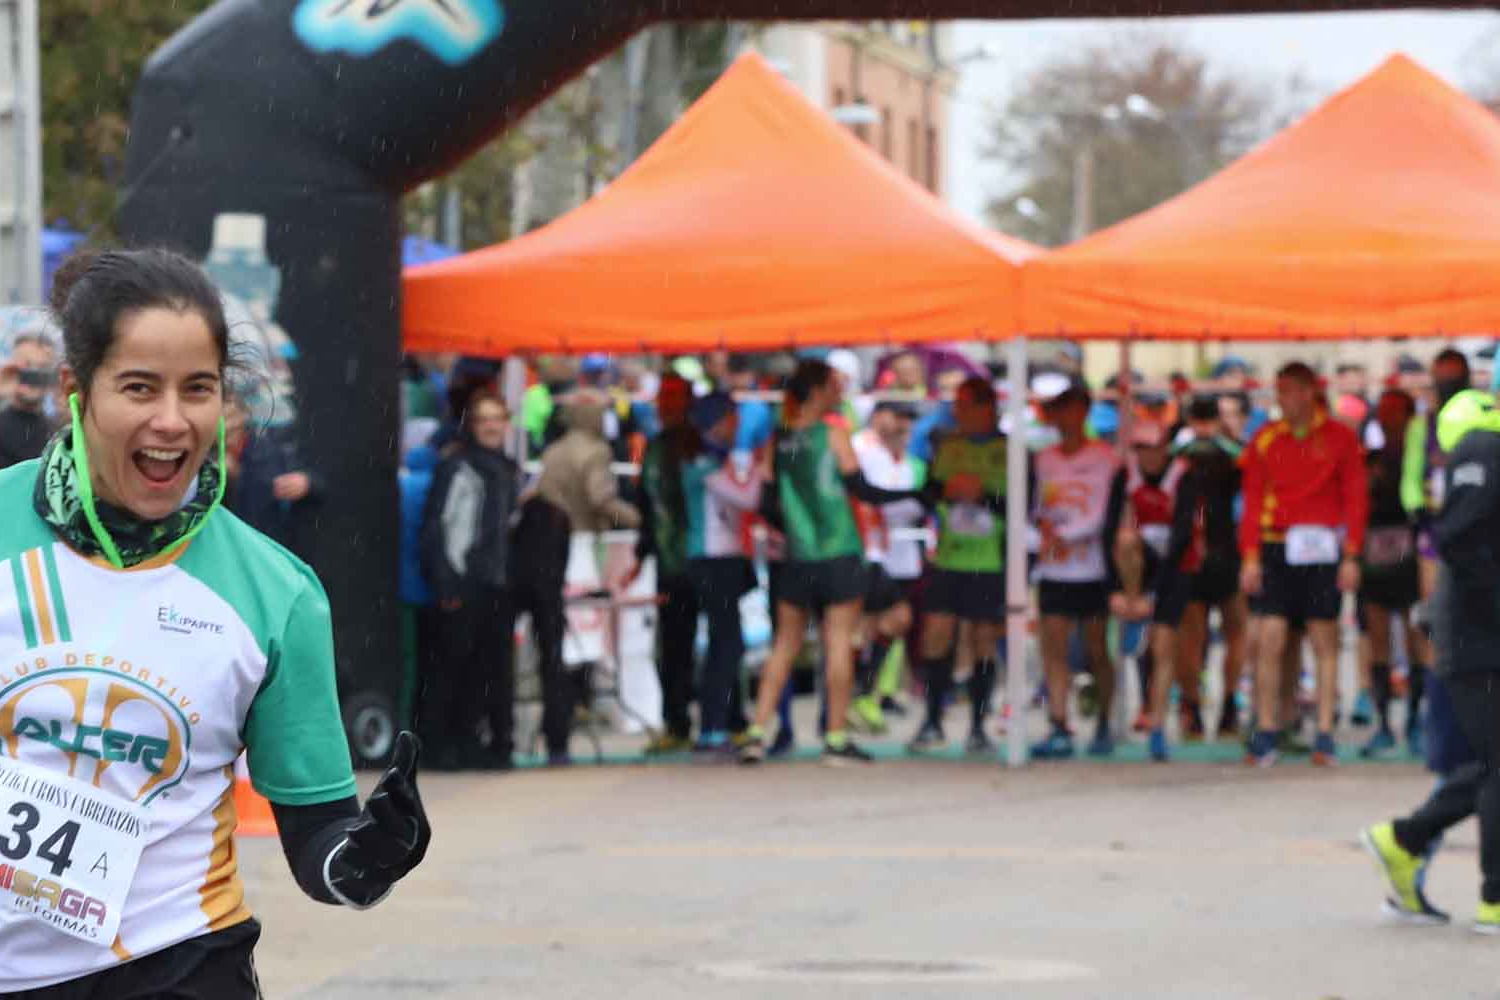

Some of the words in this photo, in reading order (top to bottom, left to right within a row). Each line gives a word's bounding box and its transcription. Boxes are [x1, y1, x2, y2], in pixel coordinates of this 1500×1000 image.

[65, 653, 201, 725] DEPORTIVO
[29, 777, 70, 809] CROSS
[71, 790, 141, 839] CABRERIZOS
[90, 851, 108, 879] A
[14, 896, 98, 939] REFORMAS
